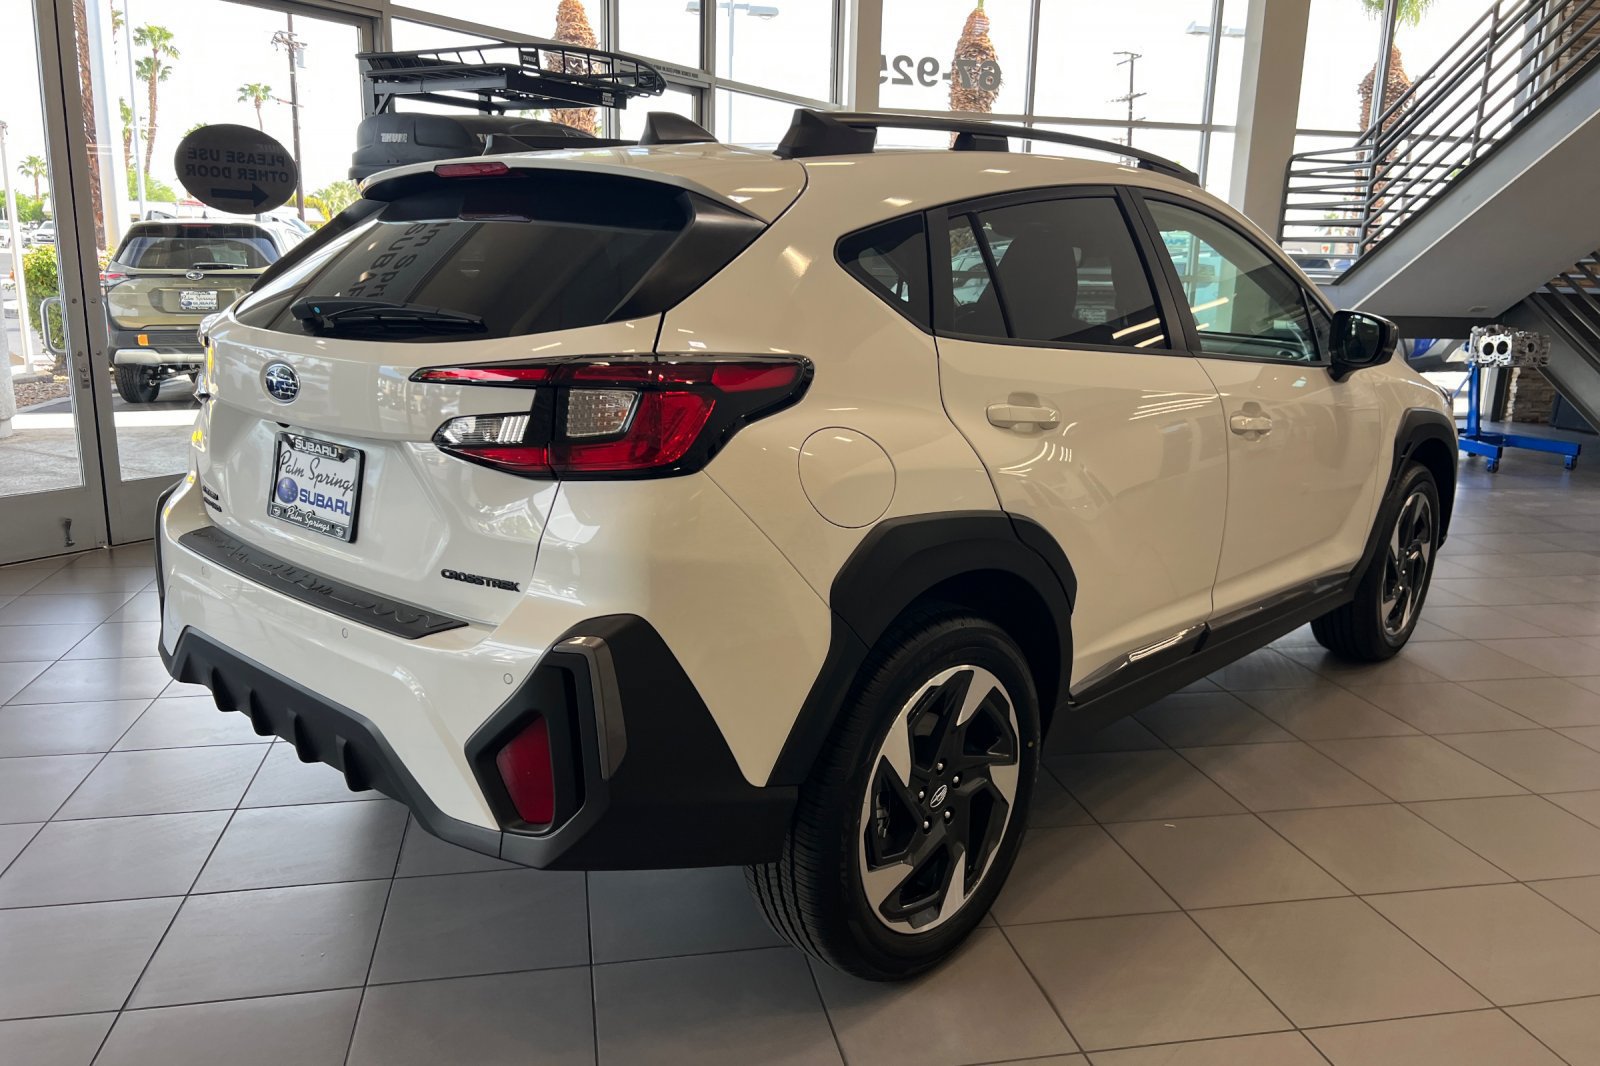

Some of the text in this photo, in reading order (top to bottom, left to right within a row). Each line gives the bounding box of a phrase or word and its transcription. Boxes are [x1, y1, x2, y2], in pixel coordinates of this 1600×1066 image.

[294, 439, 338, 458] SUBARU
[280, 449, 354, 497] Palm Springs
[286, 505, 330, 533] Palm Springs
[440, 568, 520, 592] CROSSTREK
